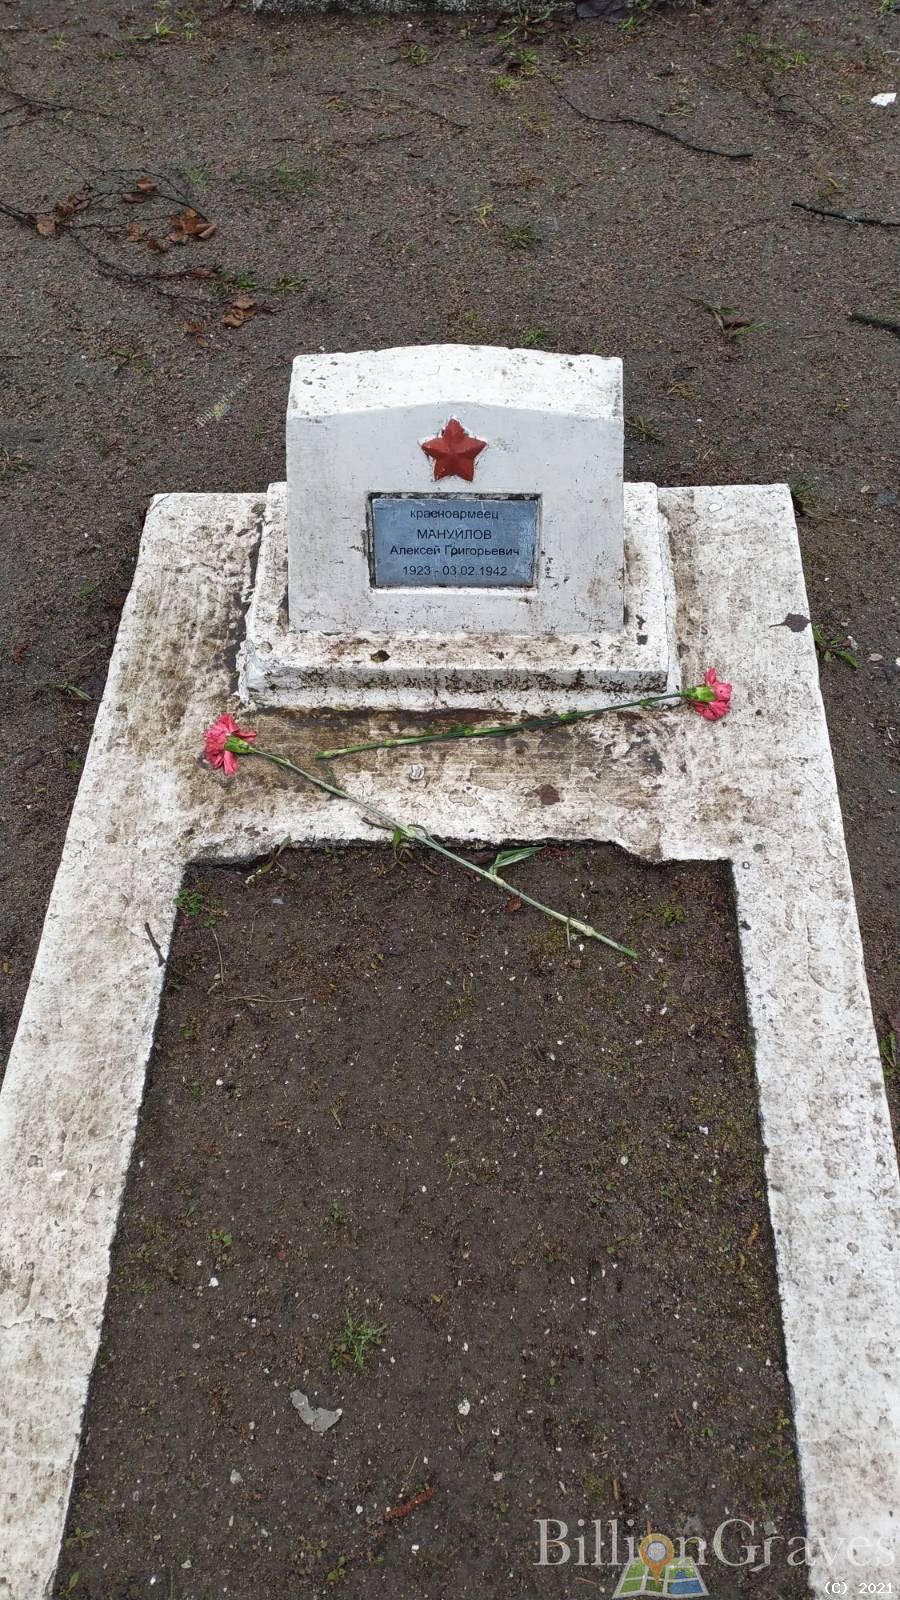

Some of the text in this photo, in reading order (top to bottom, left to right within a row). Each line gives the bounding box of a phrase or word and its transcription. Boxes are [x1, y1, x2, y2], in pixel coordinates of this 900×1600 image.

[410, 508, 498, 520] красноармеец
[417, 529, 492, 540] МАНУЙЛОВ
[390, 544, 520, 557] Алексей Григорьевич
[403, 566, 431, 576] 1923
[442, 566, 508, 576] 03.02.1942
